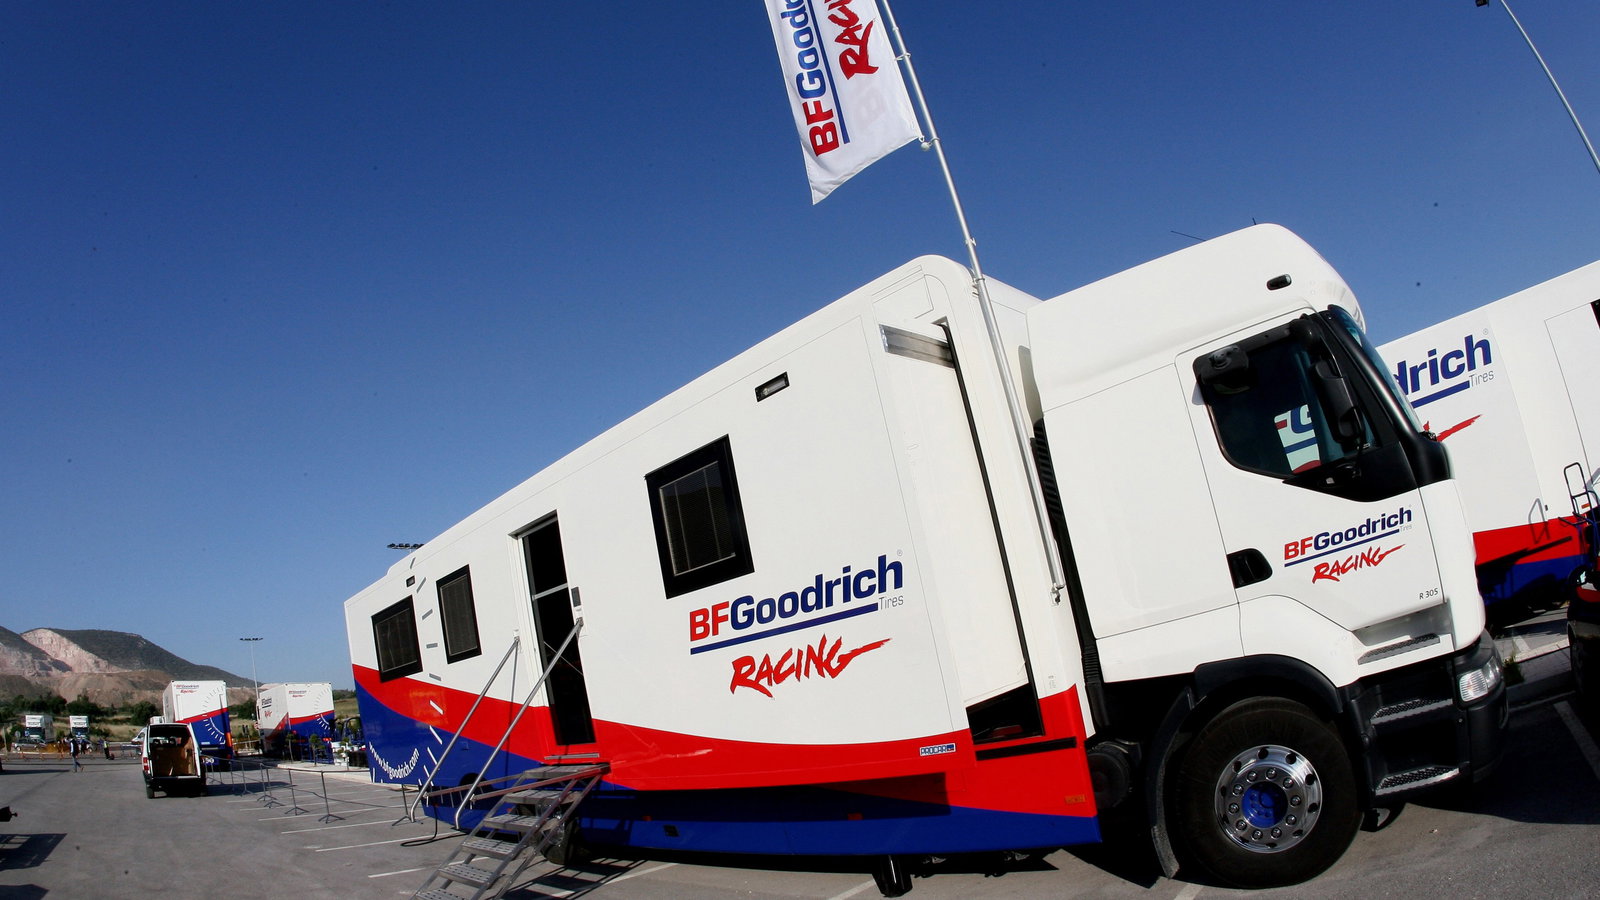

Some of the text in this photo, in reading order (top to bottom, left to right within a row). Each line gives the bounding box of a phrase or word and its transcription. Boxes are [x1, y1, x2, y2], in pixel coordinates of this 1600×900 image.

[824, 0, 879, 81] RACI
[1469, 370, 1494, 388] Tires
[1284, 507, 1412, 560] BFGoodrich
[1312, 543, 1406, 584] RACING
[690, 554, 903, 642] BFGoodrich
[878, 595, 904, 610] Tires
[730, 633, 893, 699] RACING
[920, 745, 947, 756] PROCAR
